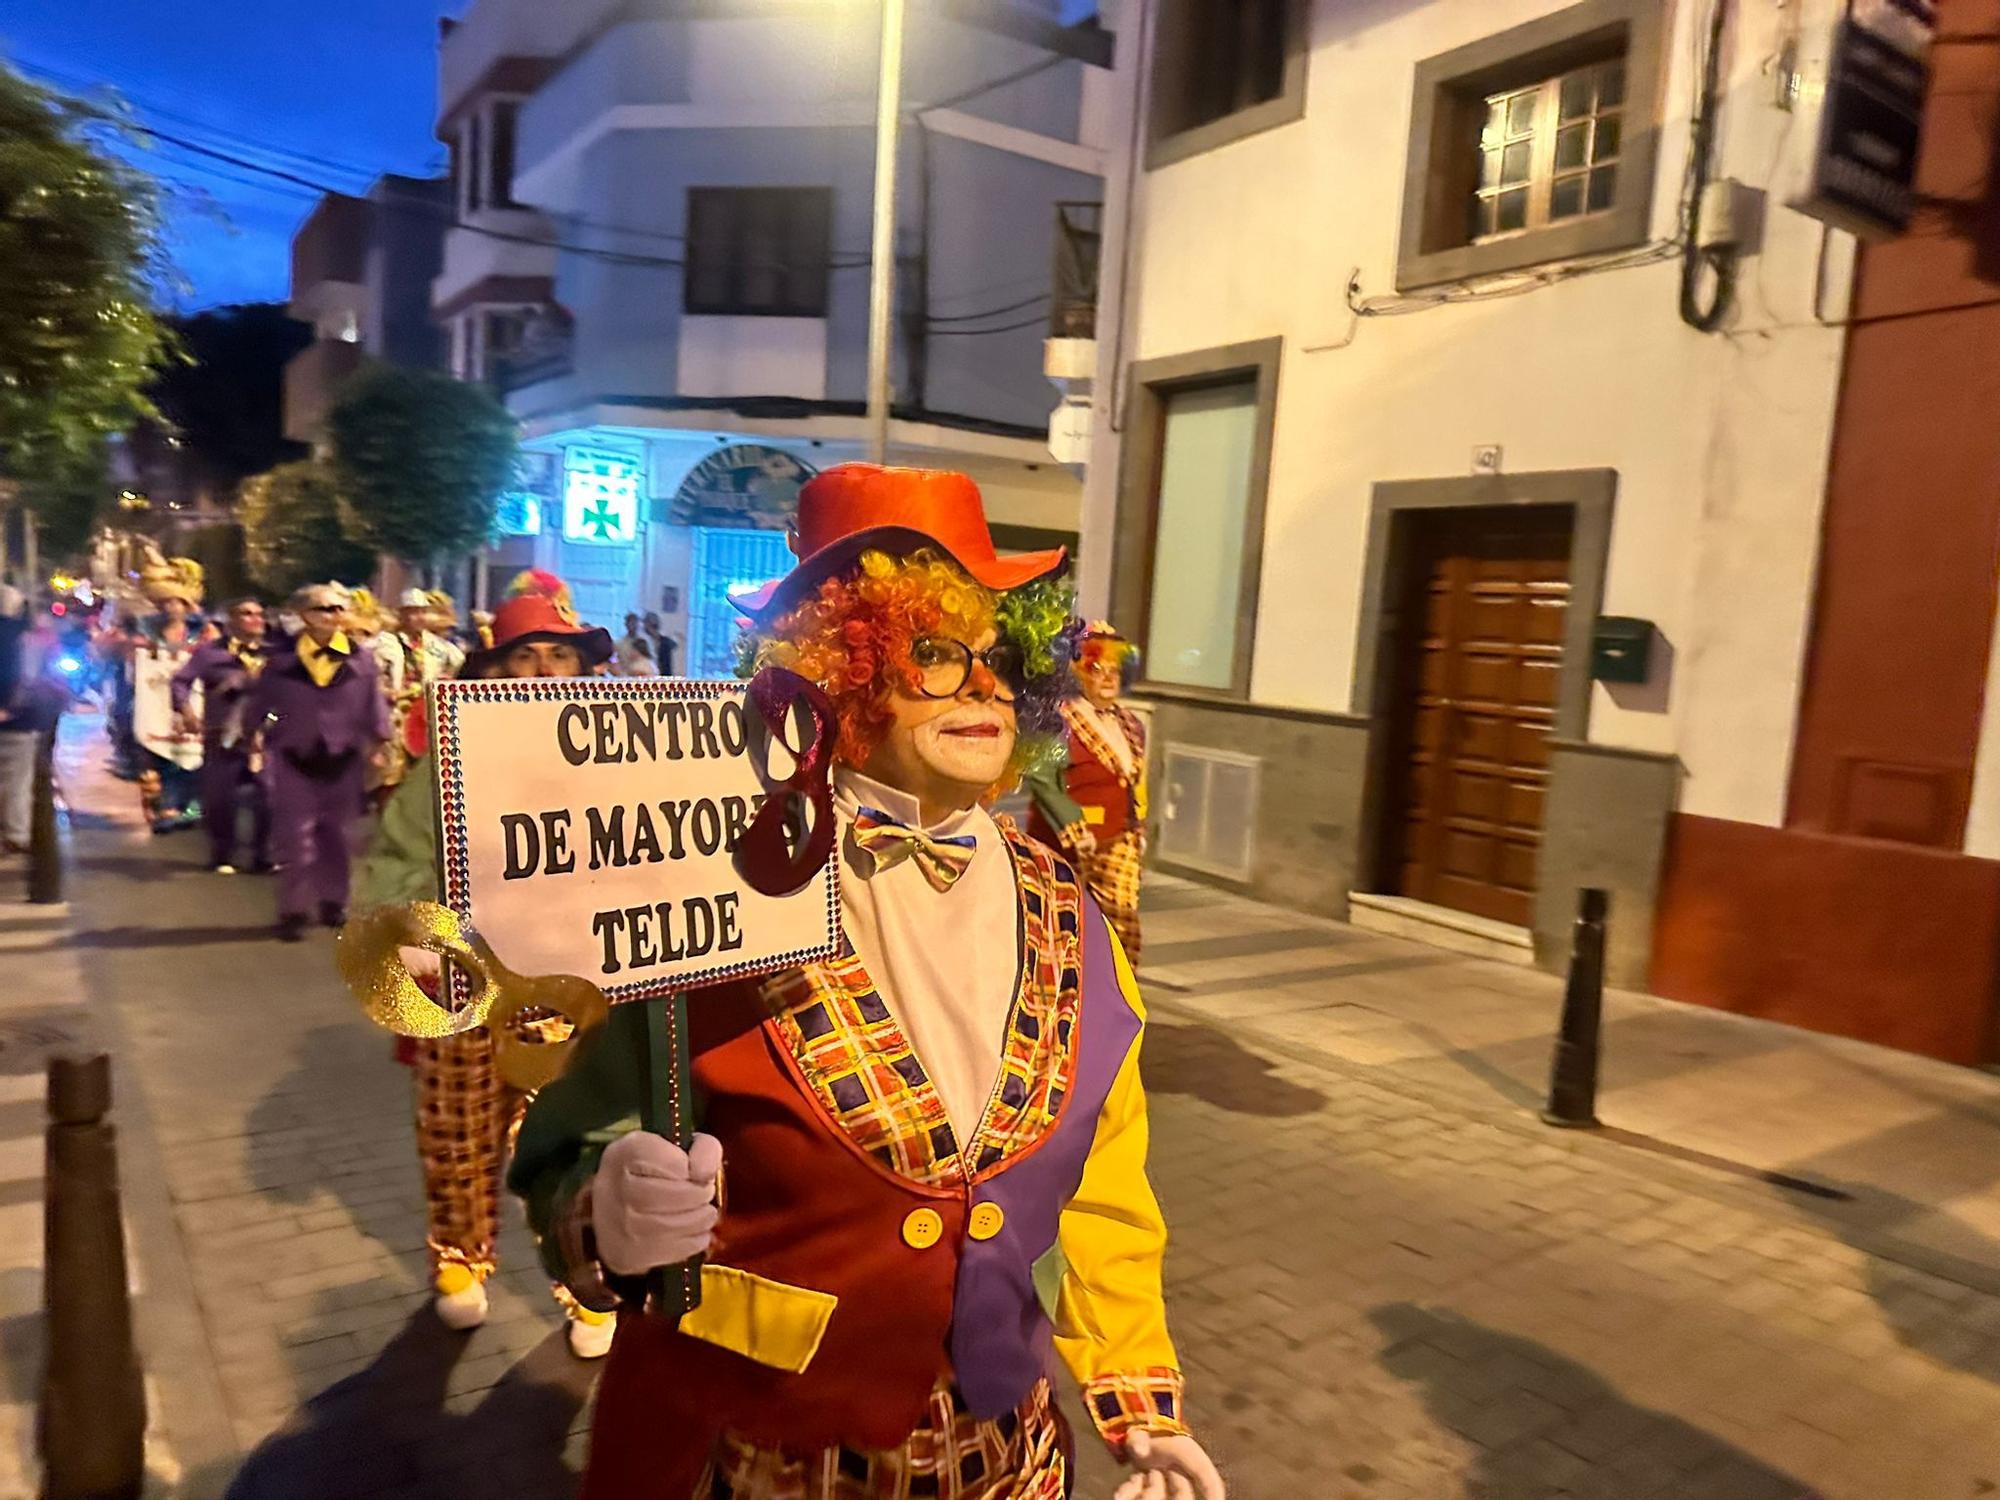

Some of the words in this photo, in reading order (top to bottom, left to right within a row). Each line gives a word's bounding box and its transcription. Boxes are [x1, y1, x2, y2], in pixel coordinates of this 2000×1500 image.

[557, 701, 747, 767] CENTRO
[500, 808, 576, 881] DE
[592, 890, 743, 975] TELDE
